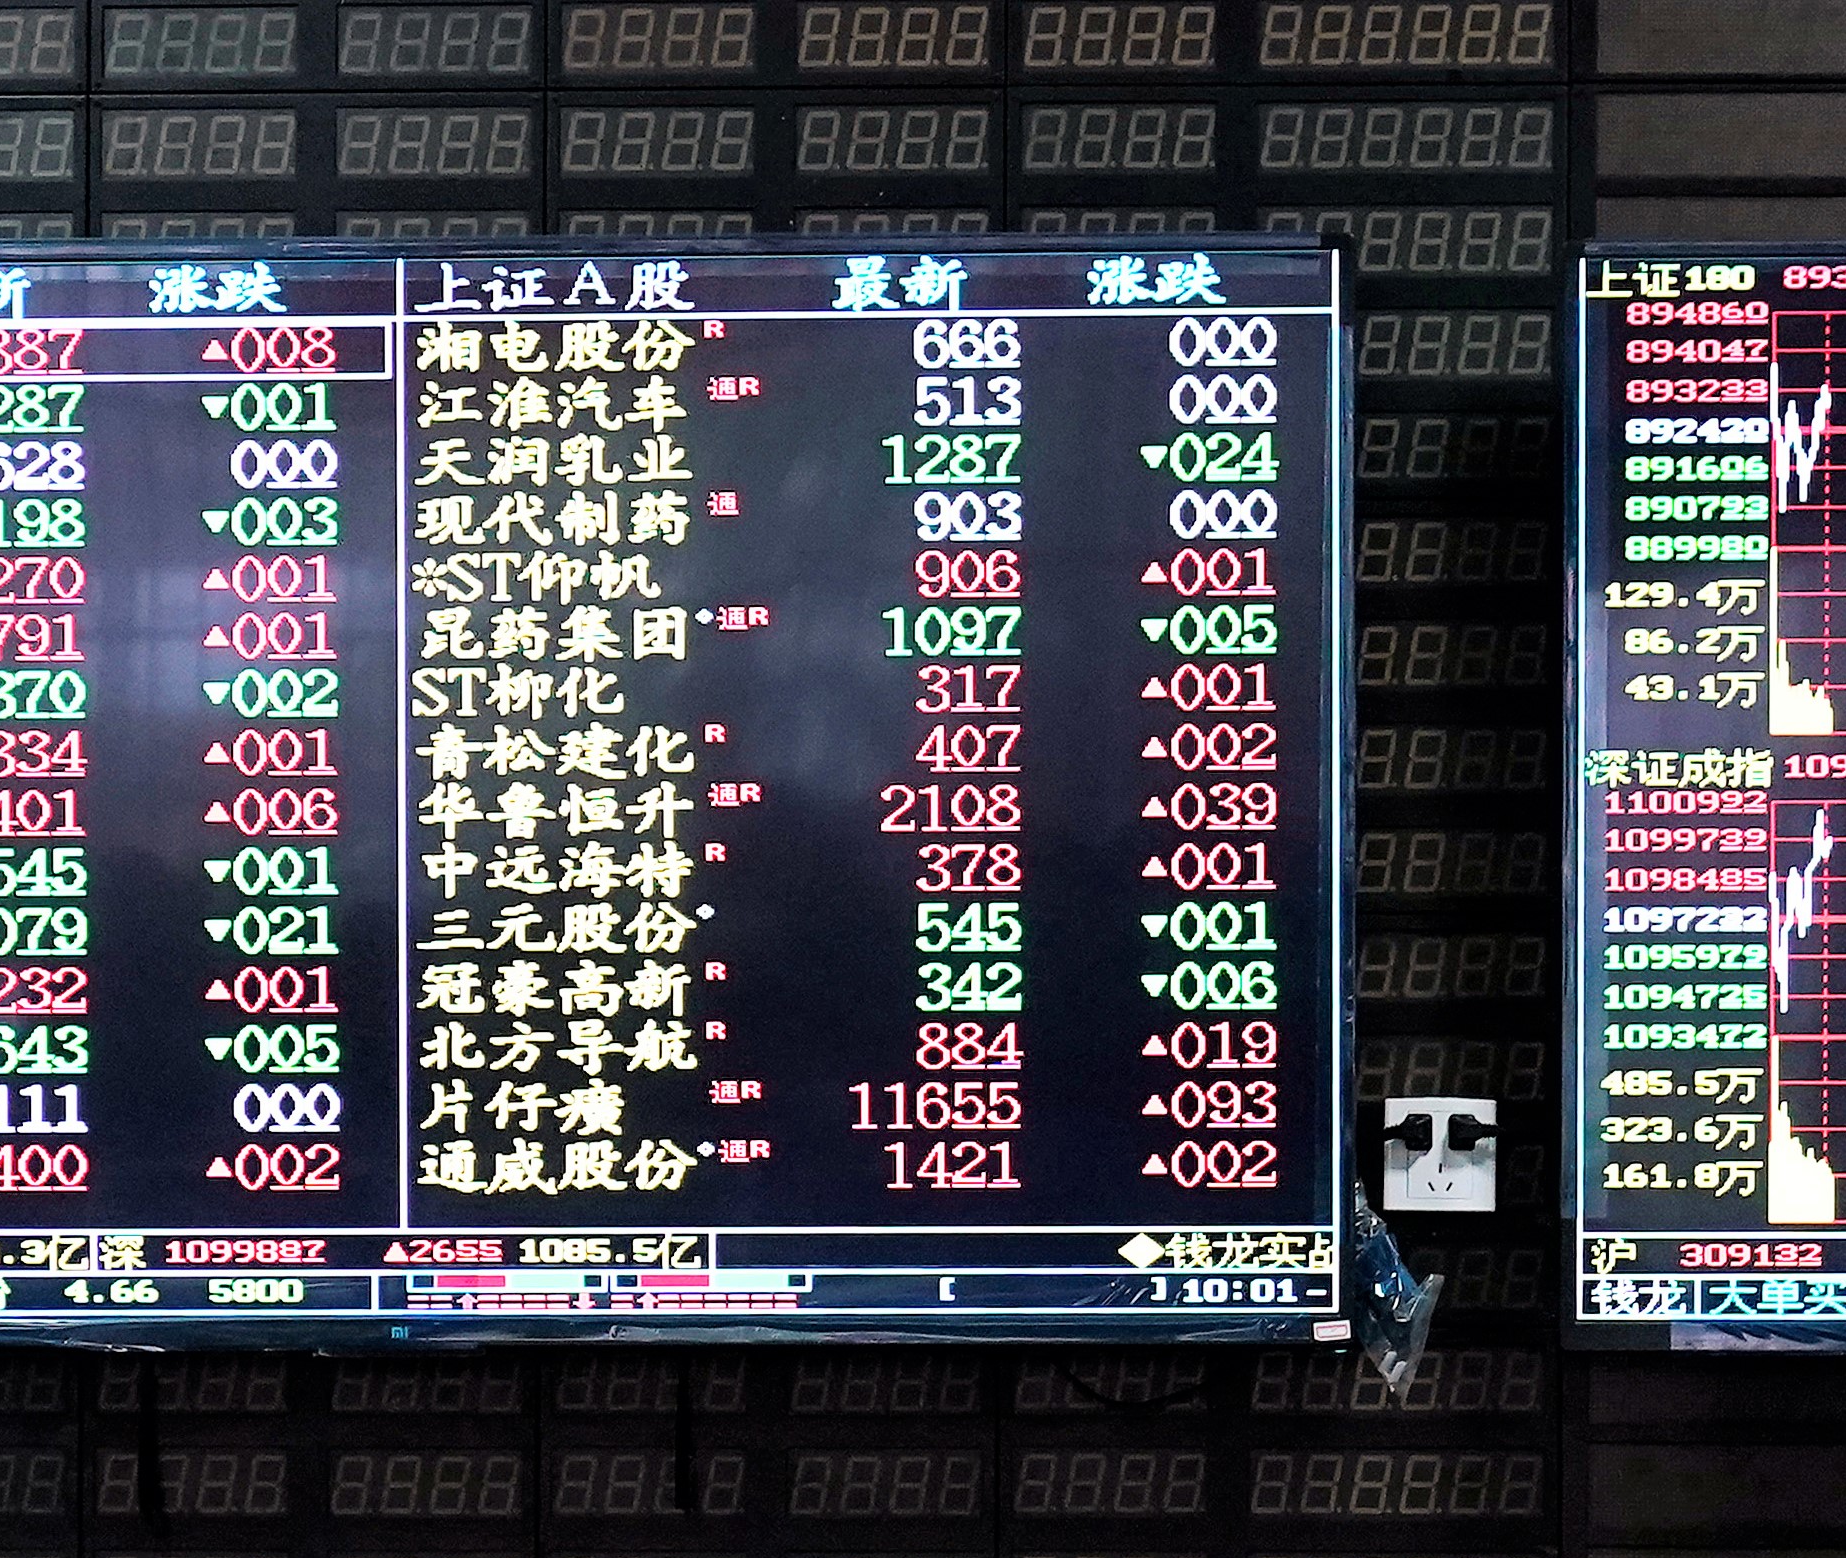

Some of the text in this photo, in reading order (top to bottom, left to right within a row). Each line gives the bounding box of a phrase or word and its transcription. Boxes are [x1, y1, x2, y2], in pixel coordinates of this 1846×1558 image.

[147, 261, 288, 313] 涨跌
[412, 252, 1227, 313] 上证A股 最新 涨跌
[1587, 261, 1756, 298] 上证180
[1625, 301, 1769, 326] 894860
[230, 327, 338, 374] 008
[409, 319, 696, 373] 湘电股份
[1625, 339, 1769, 364] 894047
[417, 374, 687, 431] 江淮汽车
[1625, 379, 1769, 404] 893233
[1624, 418, 1769, 444] 892420
[414, 431, 1280, 487] 天润乳业 1287 024
[414, 489, 691, 547] 现代制药
[1604, 579, 1766, 616] 129.4万
[229, 611, 338, 662] 001
[420, 604, 688, 663] 昆药集团
[1623, 625, 1765, 663] 86.2万
[411, 663, 625, 720] ST柳化
[1623, 672, 1765, 709] 43.1万
[415, 721, 695, 780] 青松建化
[1585, 748, 1775, 789] 深证成指
[418, 781, 1277, 840] 华鲁恒升 2108 039
[1604, 790, 1768, 815] 1100992
[421, 840, 694, 899] 中远海特
[1604, 868, 1768, 893] 1098485
[416, 902, 697, 954] 三元股份
[416, 959, 1278, 1018] 冠豪高新 342 006
[419, 1018, 697, 1076] 北方导航
[233, 1082, 342, 1133] 000
[419, 1077, 1277, 1136] 片仔癀 11655 093
[1599, 1114, 1764, 1151] 323.6万
[417, 1137, 697, 1195] 通威股份
[98, 1235, 147, 1270] 深
[164, 1239, 327, 1264] 1099887
[409, 1239, 504, 1264] 2655
[518, 1235, 703, 1269] 1085.5亿
[62, 1279, 159, 1304] 4.66
[207, 1278, 305, 1303] 5800
[1183, 1278, 1298, 1303] 10:01
